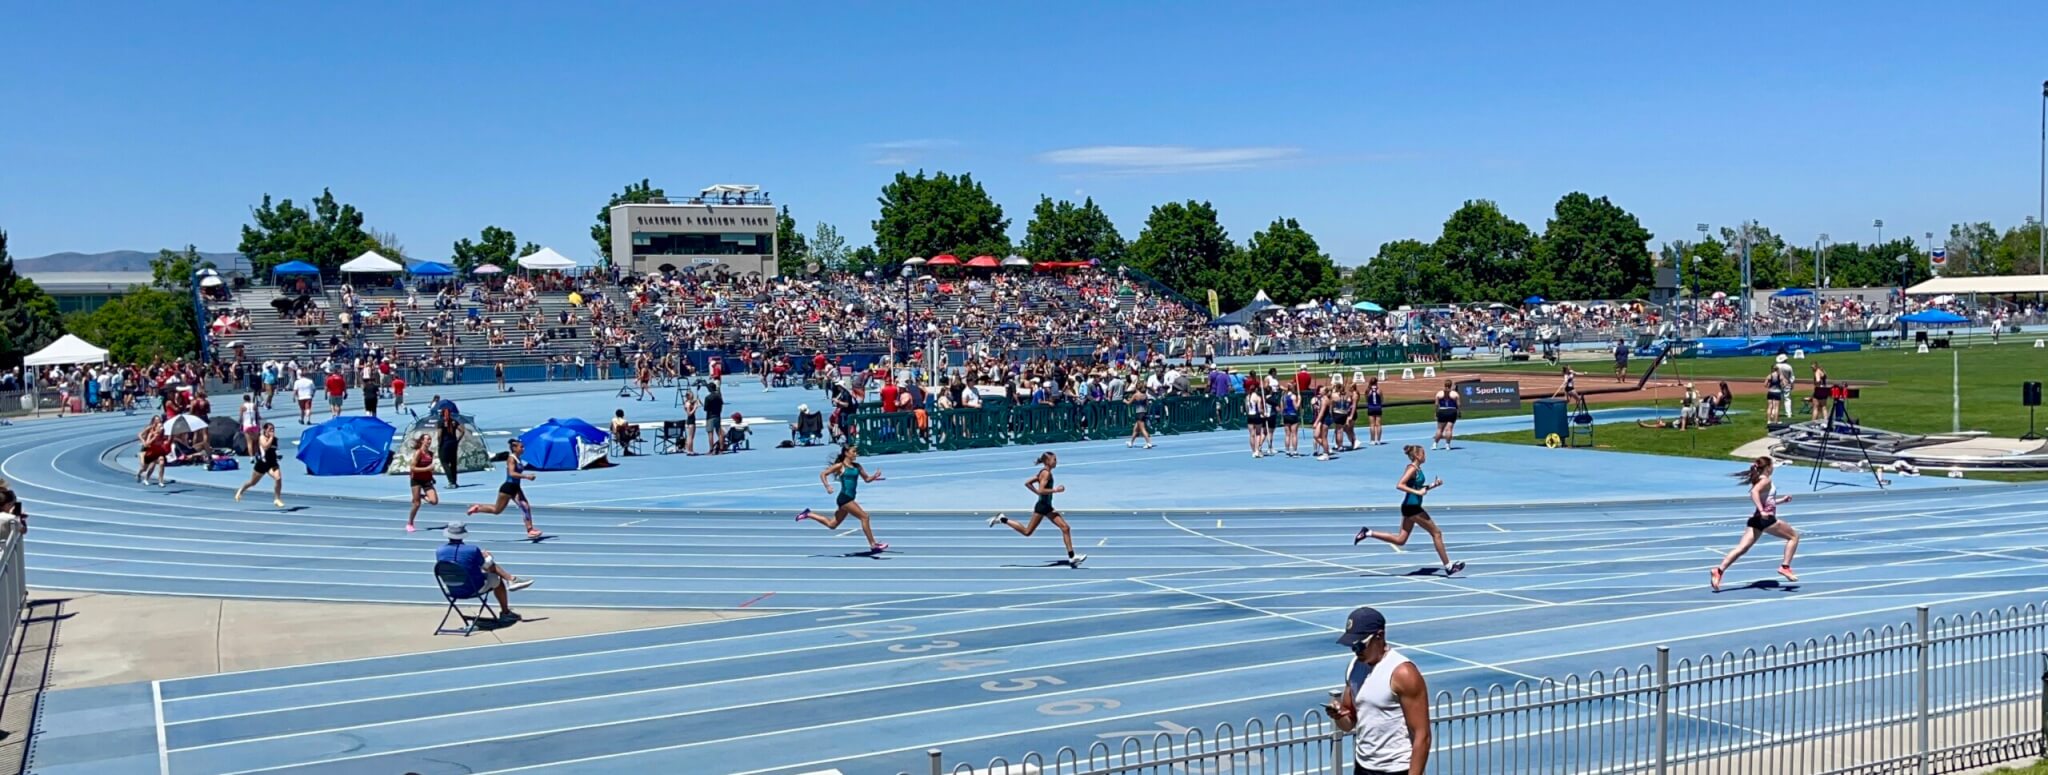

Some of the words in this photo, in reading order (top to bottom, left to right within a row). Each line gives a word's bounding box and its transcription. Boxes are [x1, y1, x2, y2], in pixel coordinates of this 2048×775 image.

[845, 624, 918, 638] 2
[888, 640, 960, 653] 3
[937, 659, 1009, 671] 4
[980, 675, 1068, 692] 5
[1036, 698, 1121, 715] 6
